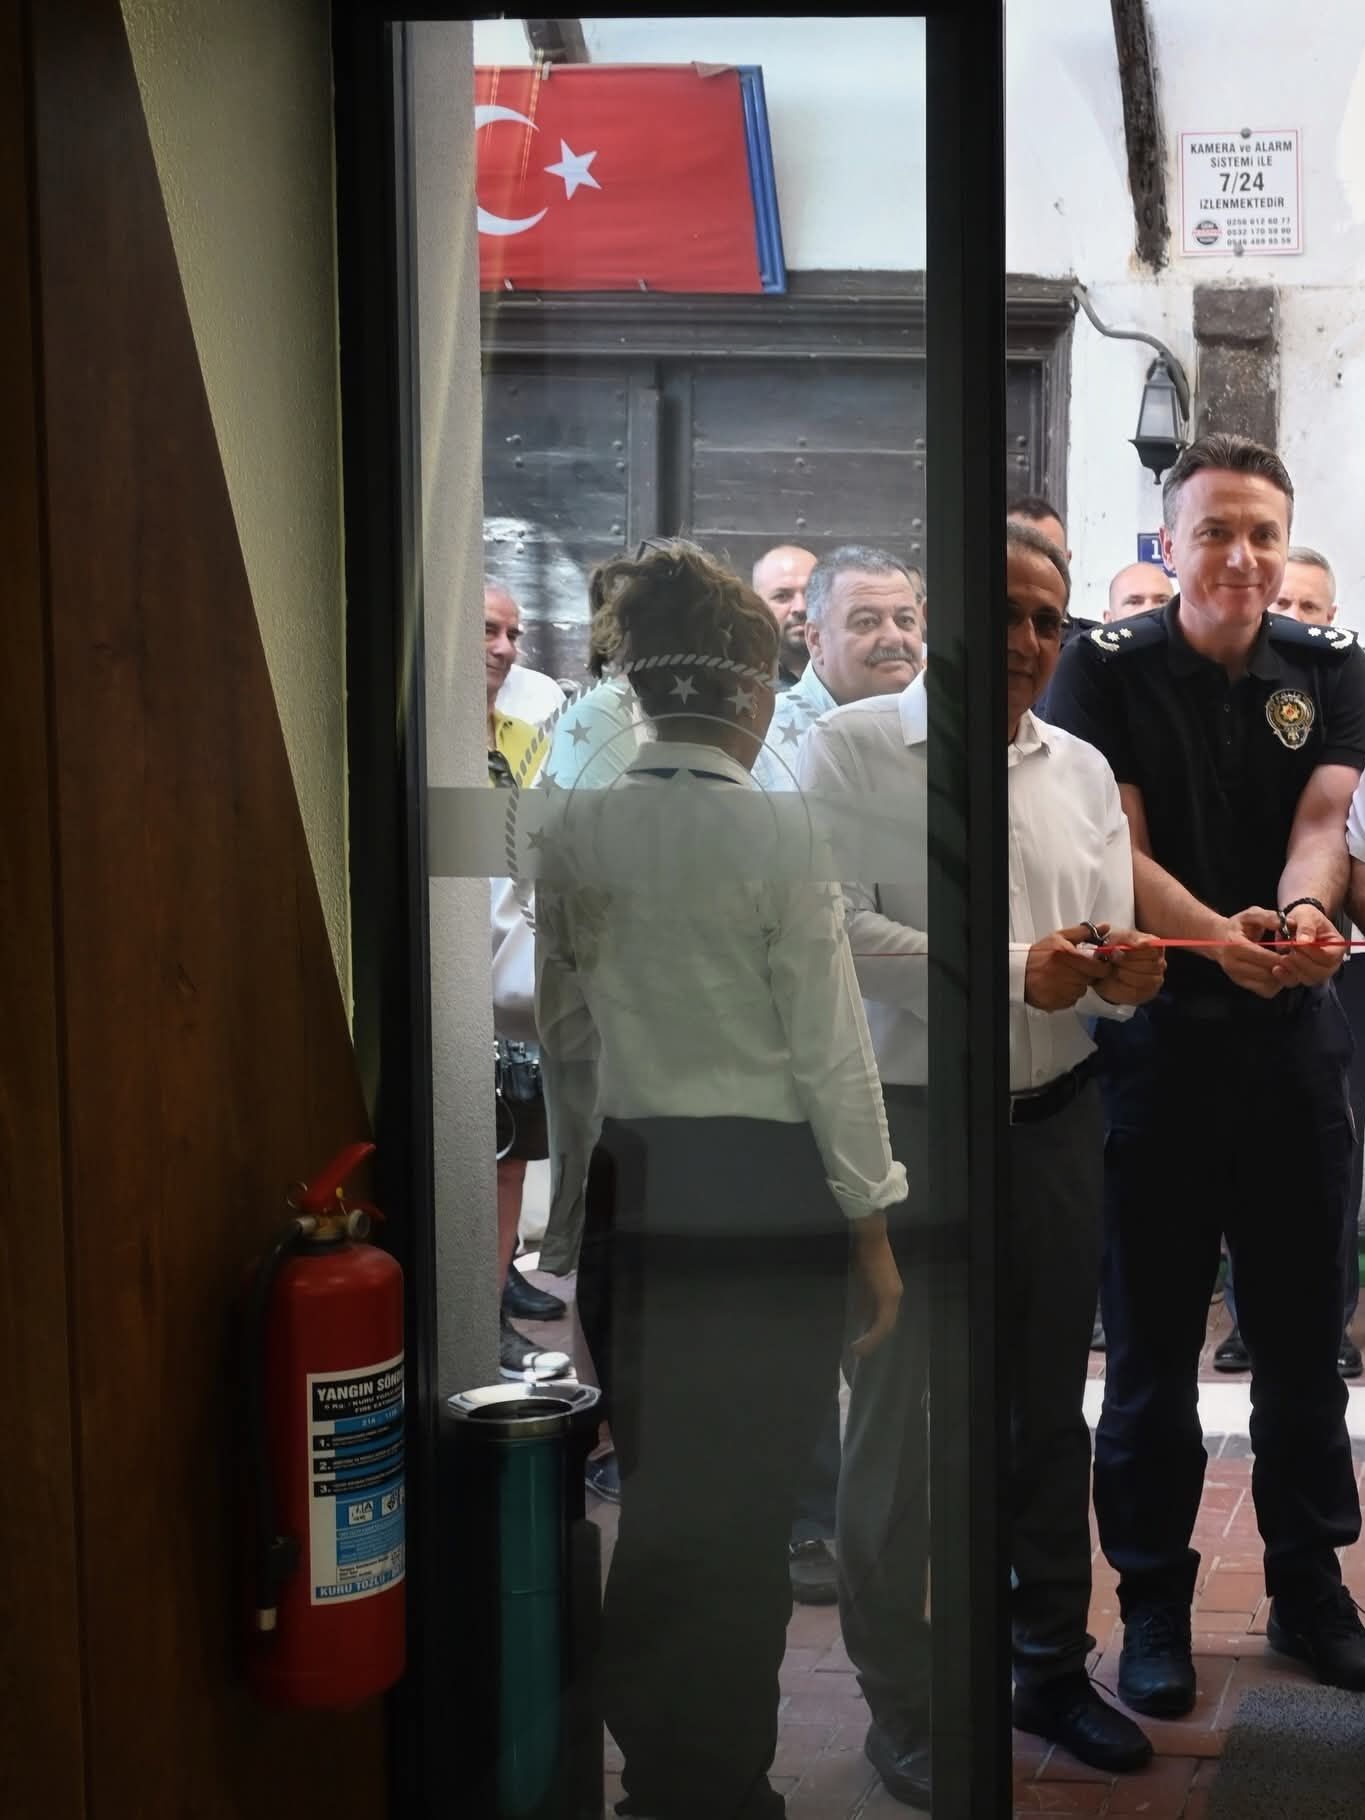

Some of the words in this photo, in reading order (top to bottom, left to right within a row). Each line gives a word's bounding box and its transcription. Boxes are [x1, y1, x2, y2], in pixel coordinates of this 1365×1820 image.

[1190, 143, 1236, 154] KAMERA
[1239, 144, 1251, 152] ve
[1255, 140, 1292, 152] ALARM
[1210, 156, 1254, 168] SİSTEMİ
[1257, 156, 1272, 166] İLE
[1219, 172, 1264, 194] 7/24
[1200, 197, 1284, 209] İZLENMEKTEDİR
[317, 1380, 374, 1402] YANGIN
[320, 1583, 352, 1597] KURU
